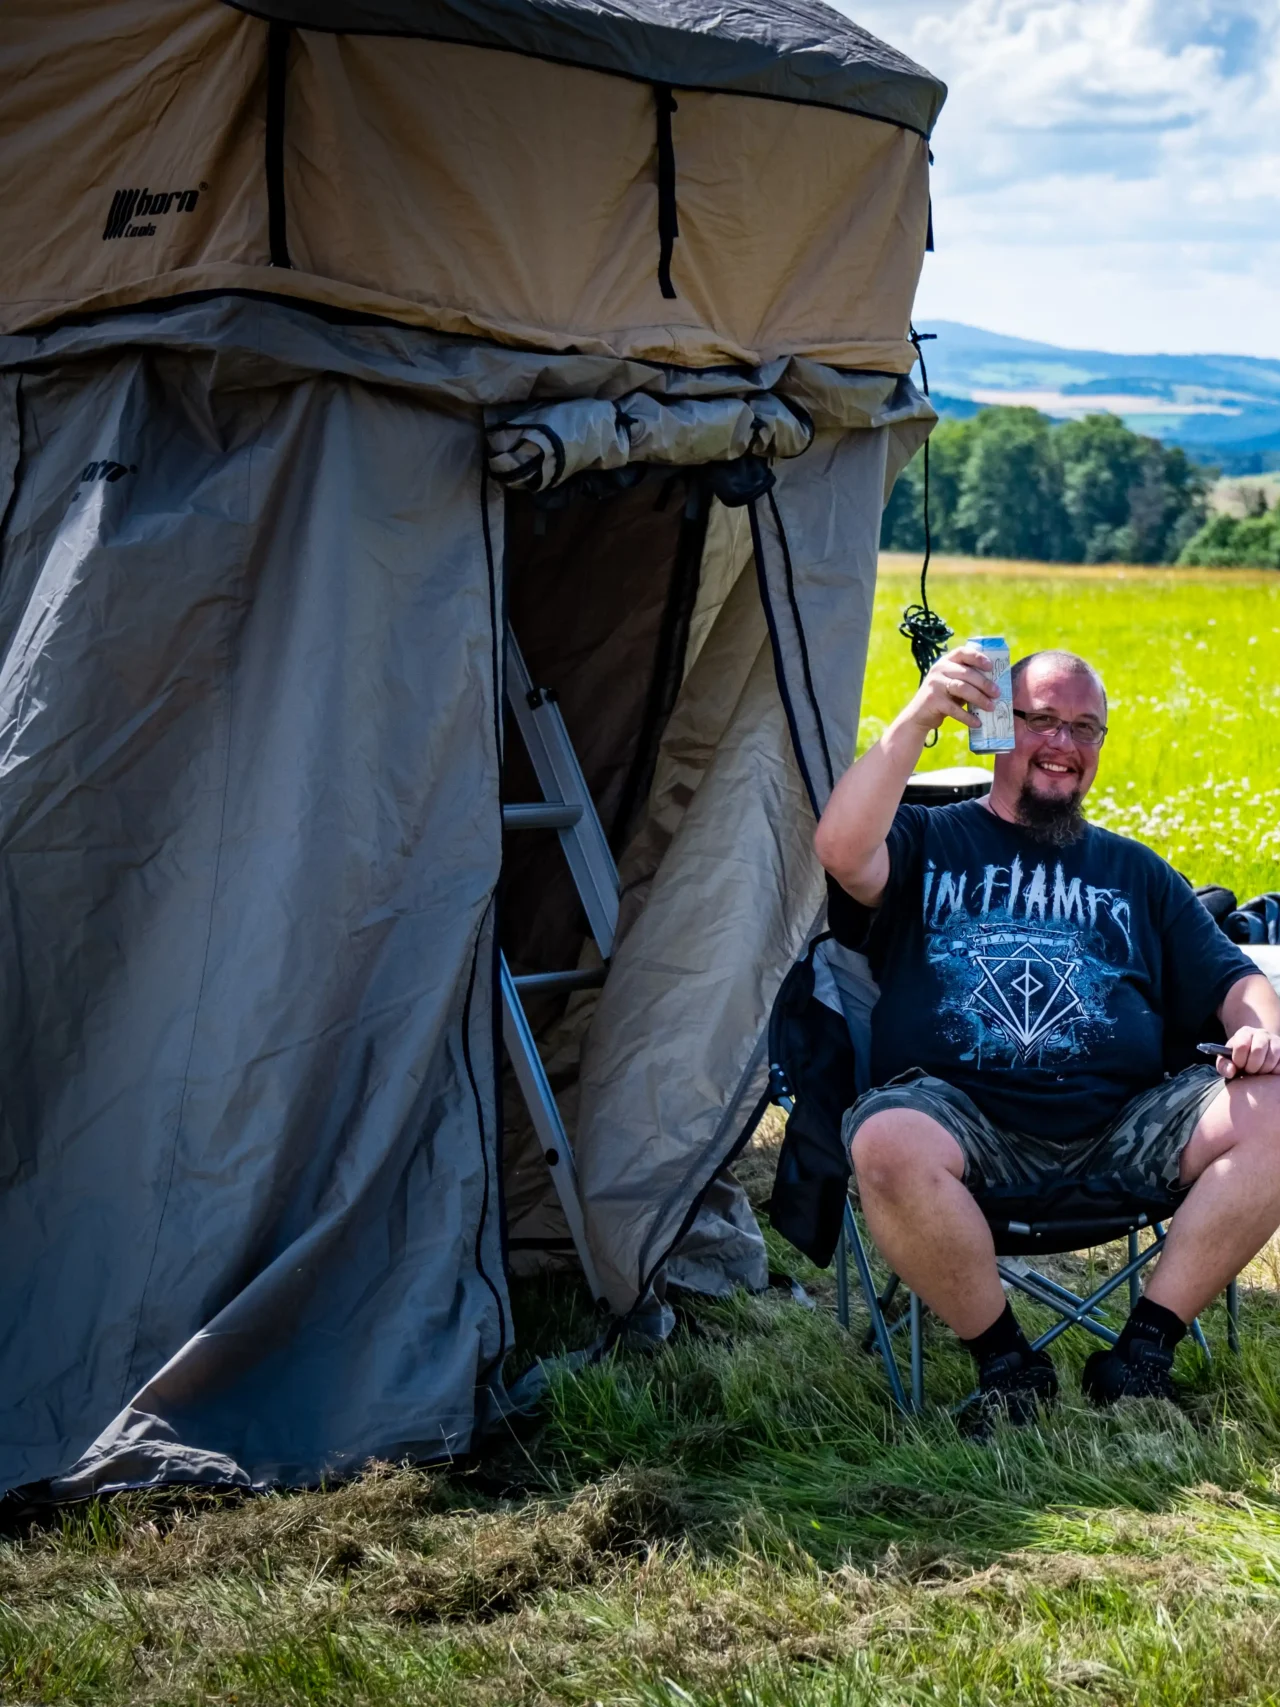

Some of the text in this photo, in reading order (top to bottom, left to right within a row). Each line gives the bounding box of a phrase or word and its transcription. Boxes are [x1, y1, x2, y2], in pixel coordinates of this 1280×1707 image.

[136, 188, 199, 216] horn
[125, 223, 156, 238] tools
[80, 459, 128, 482] orn
[923, 858, 967, 927] IN
